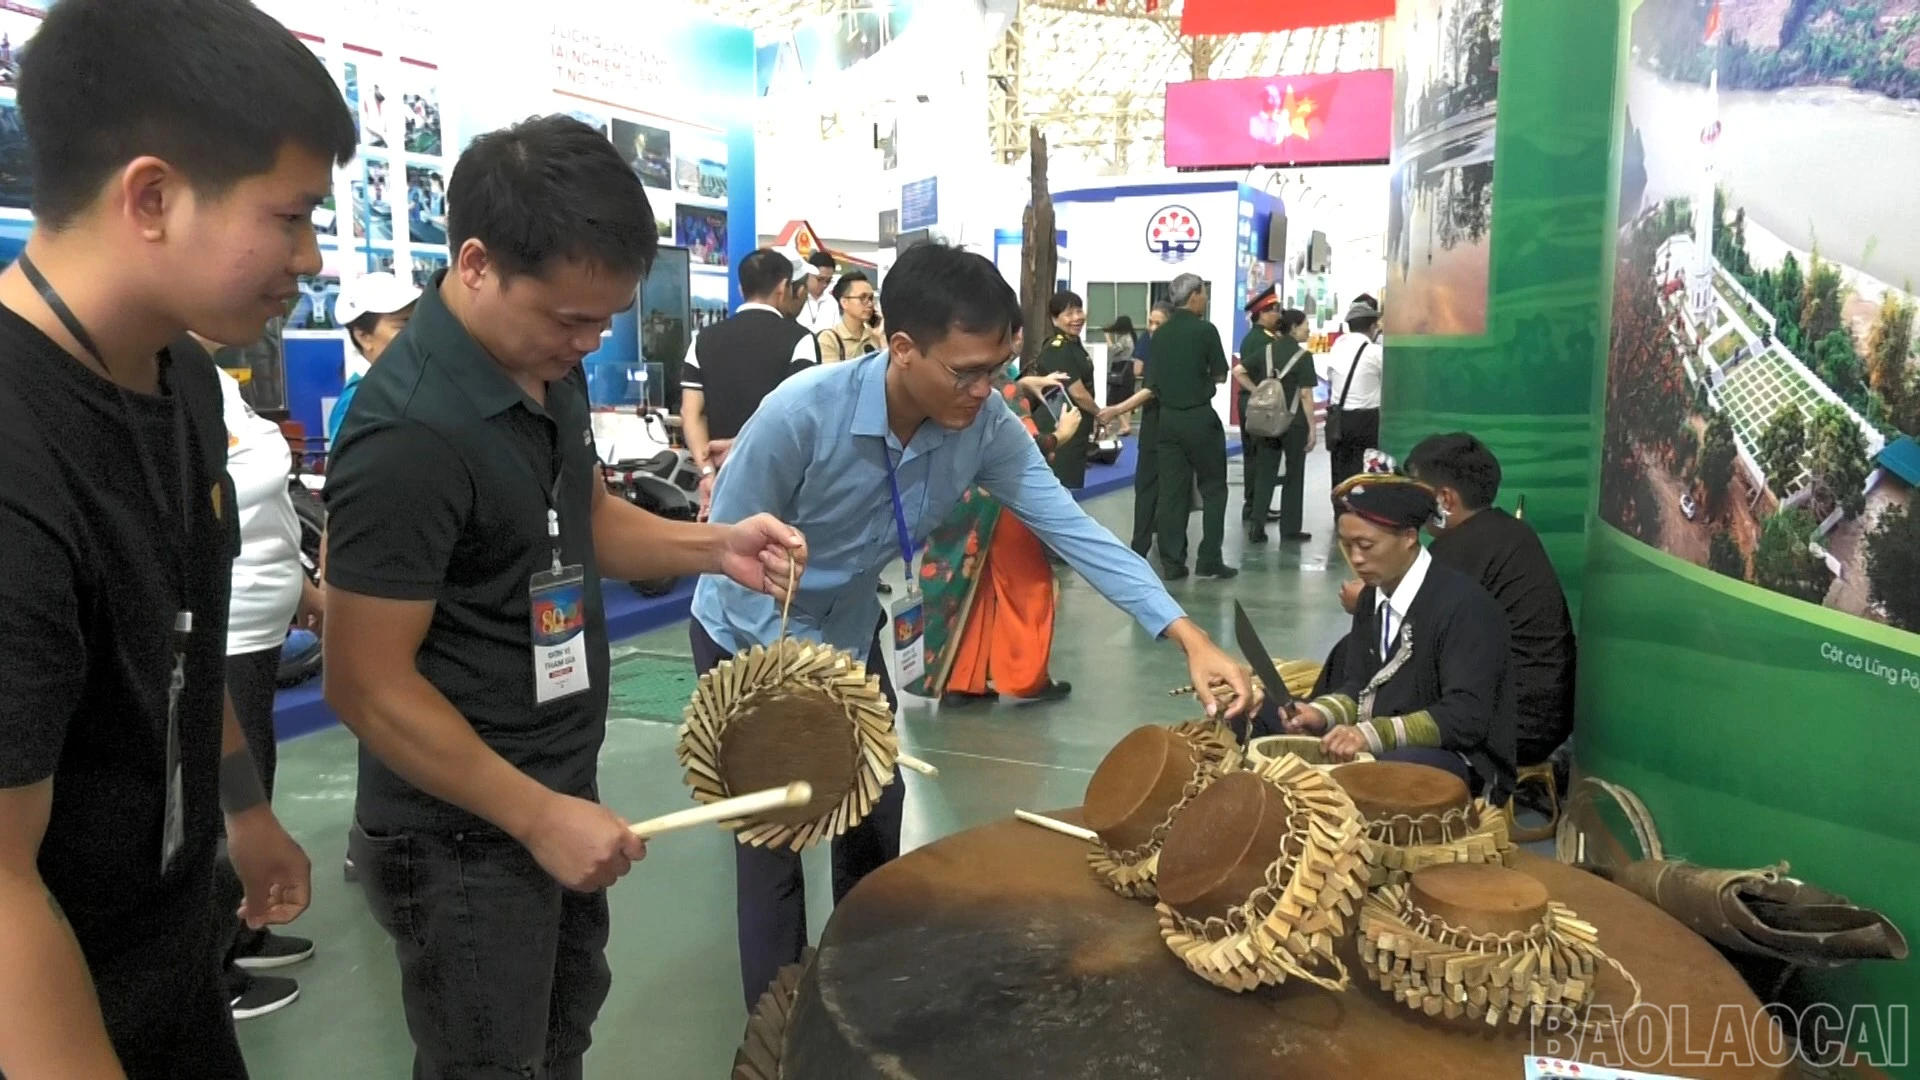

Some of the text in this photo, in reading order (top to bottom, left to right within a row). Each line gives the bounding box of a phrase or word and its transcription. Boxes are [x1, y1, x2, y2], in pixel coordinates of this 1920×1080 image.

[1820, 641, 1843, 664] Cột
[1846, 652, 1863, 670] cờ
[1864, 656, 1898, 686] Lũng
